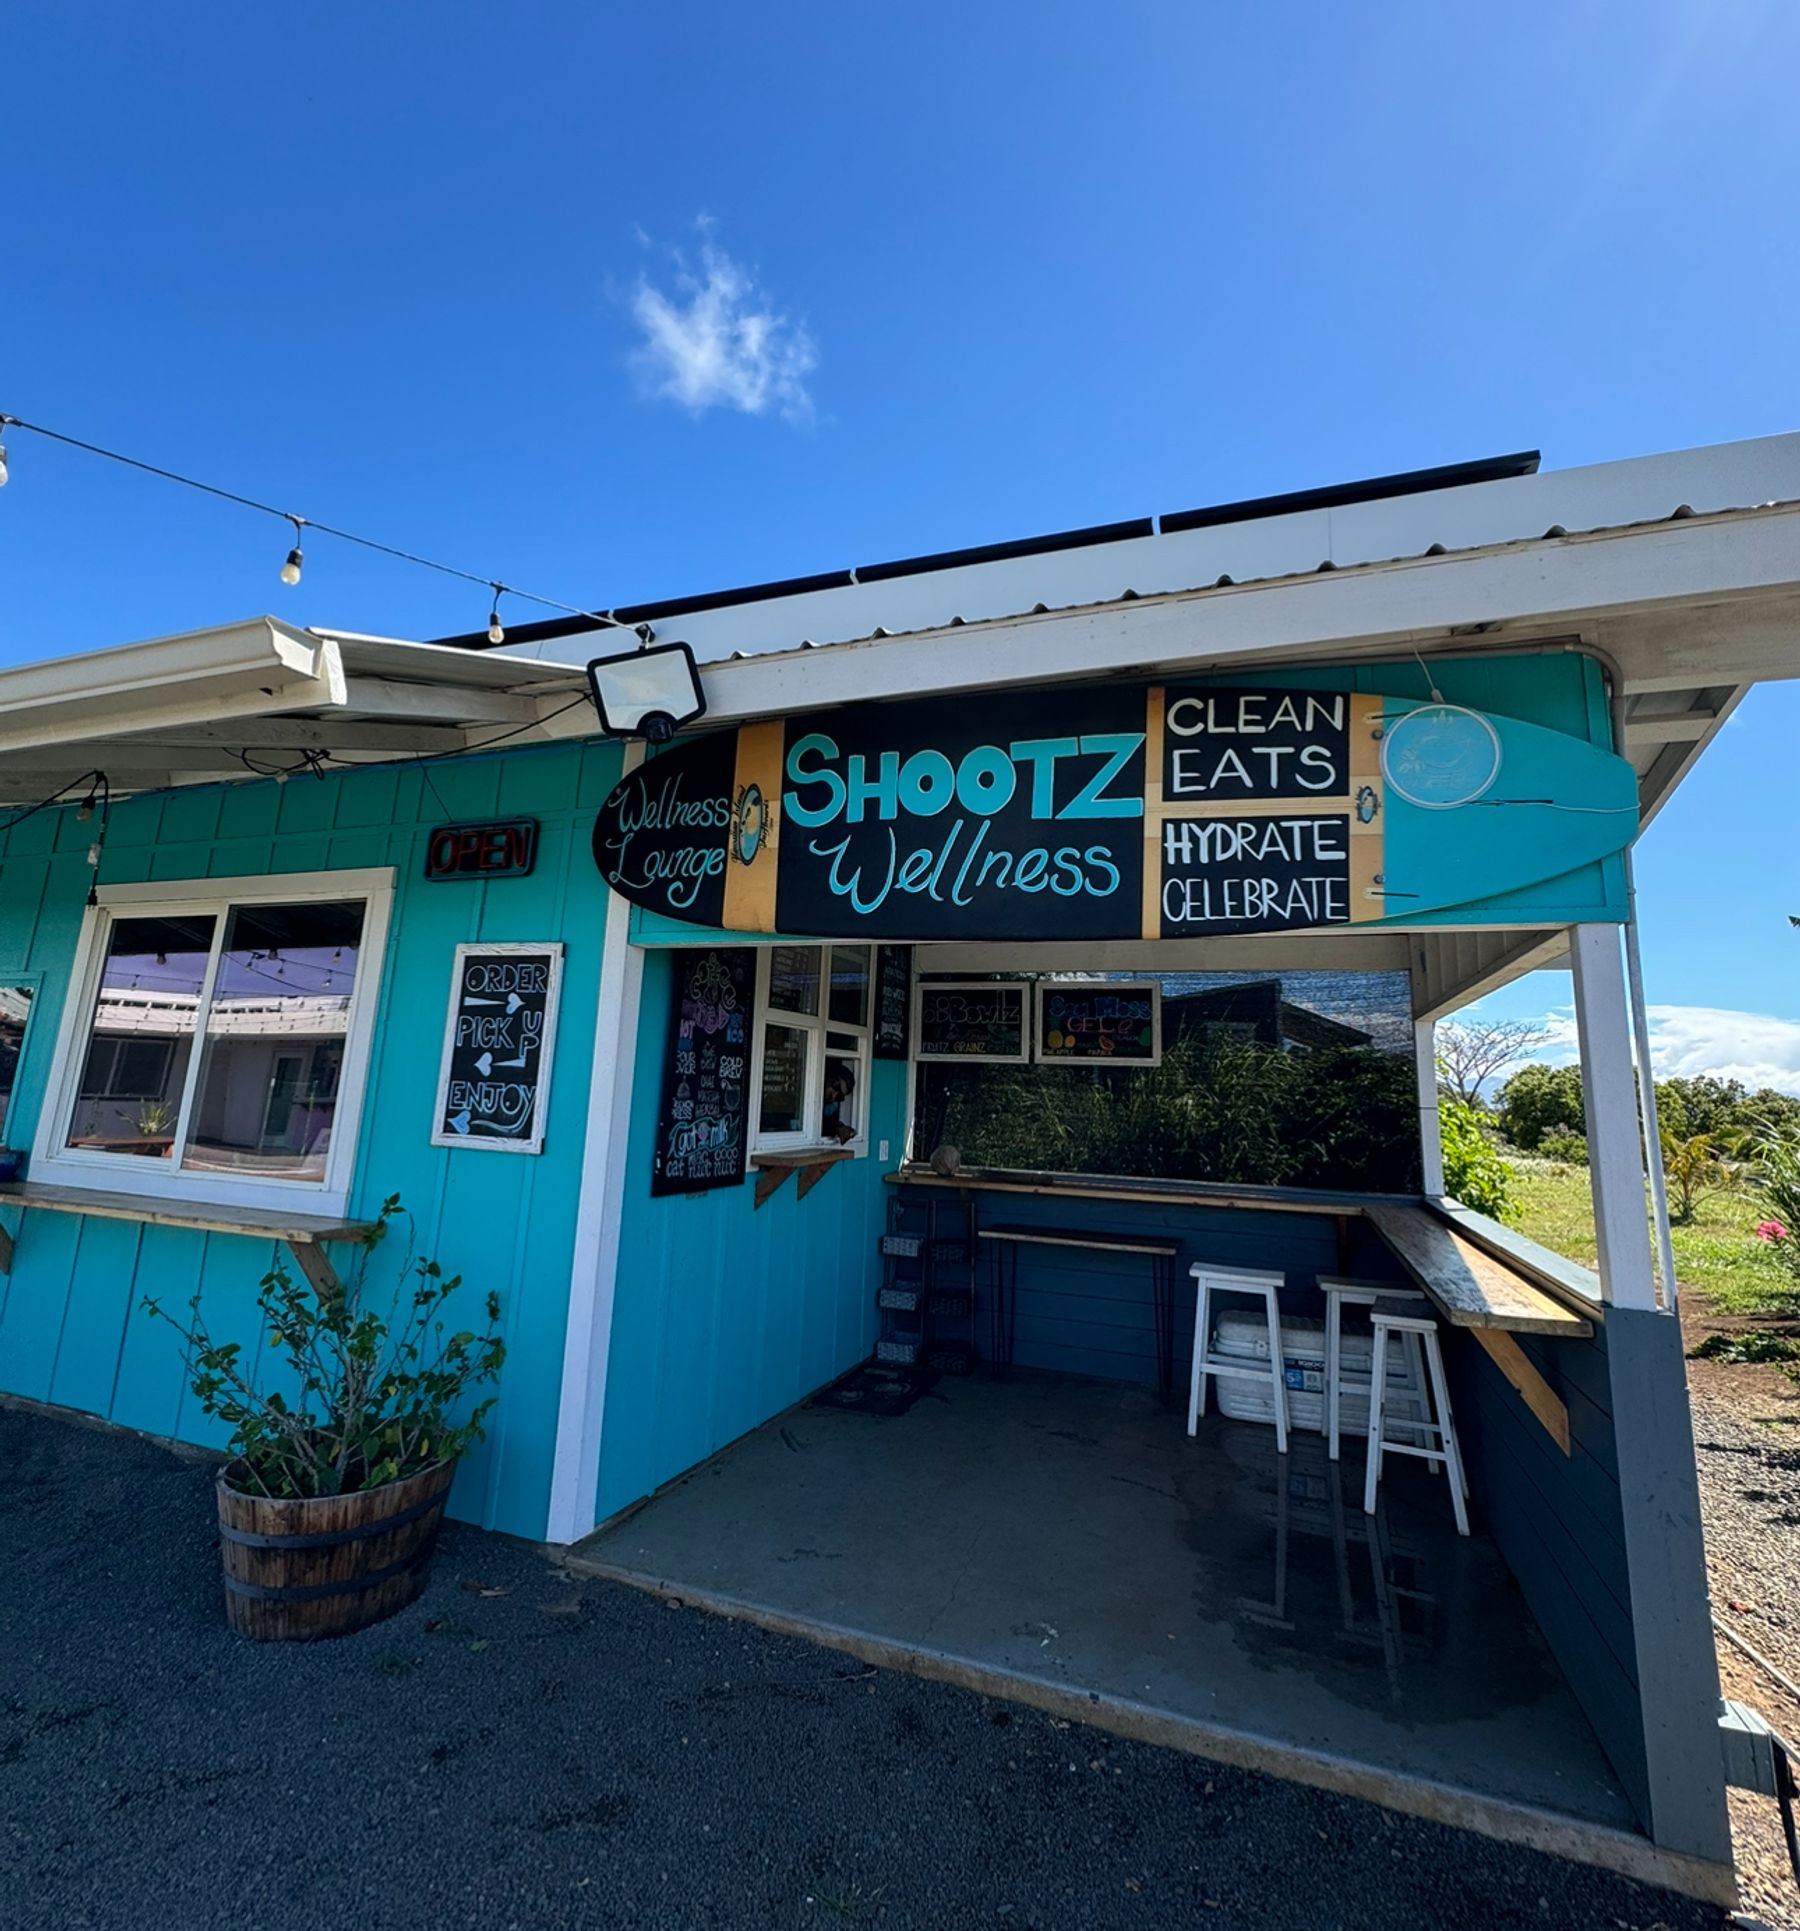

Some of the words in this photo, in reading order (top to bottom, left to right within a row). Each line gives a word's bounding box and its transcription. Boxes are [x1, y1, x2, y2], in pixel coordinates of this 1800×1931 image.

[1166, 695, 1344, 737] CLEAN
[783, 733, 1147, 828] SHOOTZ
[1172, 745, 1337, 794] EATS
[608, 772, 731, 833] Wellness
[430, 827, 527, 873] OPEN
[1164, 819, 1347, 866] HYDRATE
[604, 833, 725, 908] Lounge
[809, 819, 1121, 914] Wellness
[1162, 877, 1349, 923] CELEBRATE
[465, 964, 548, 993] ORDER
[1094, 996, 1152, 1020] Moss
[456, 1015, 515, 1049] PICK
[519, 1010, 543, 1059] UP
[719, 1066, 743, 1079] BREW
[720, 1055, 744, 1068] COLD
[449, 1079, 537, 1119] ENJOY
